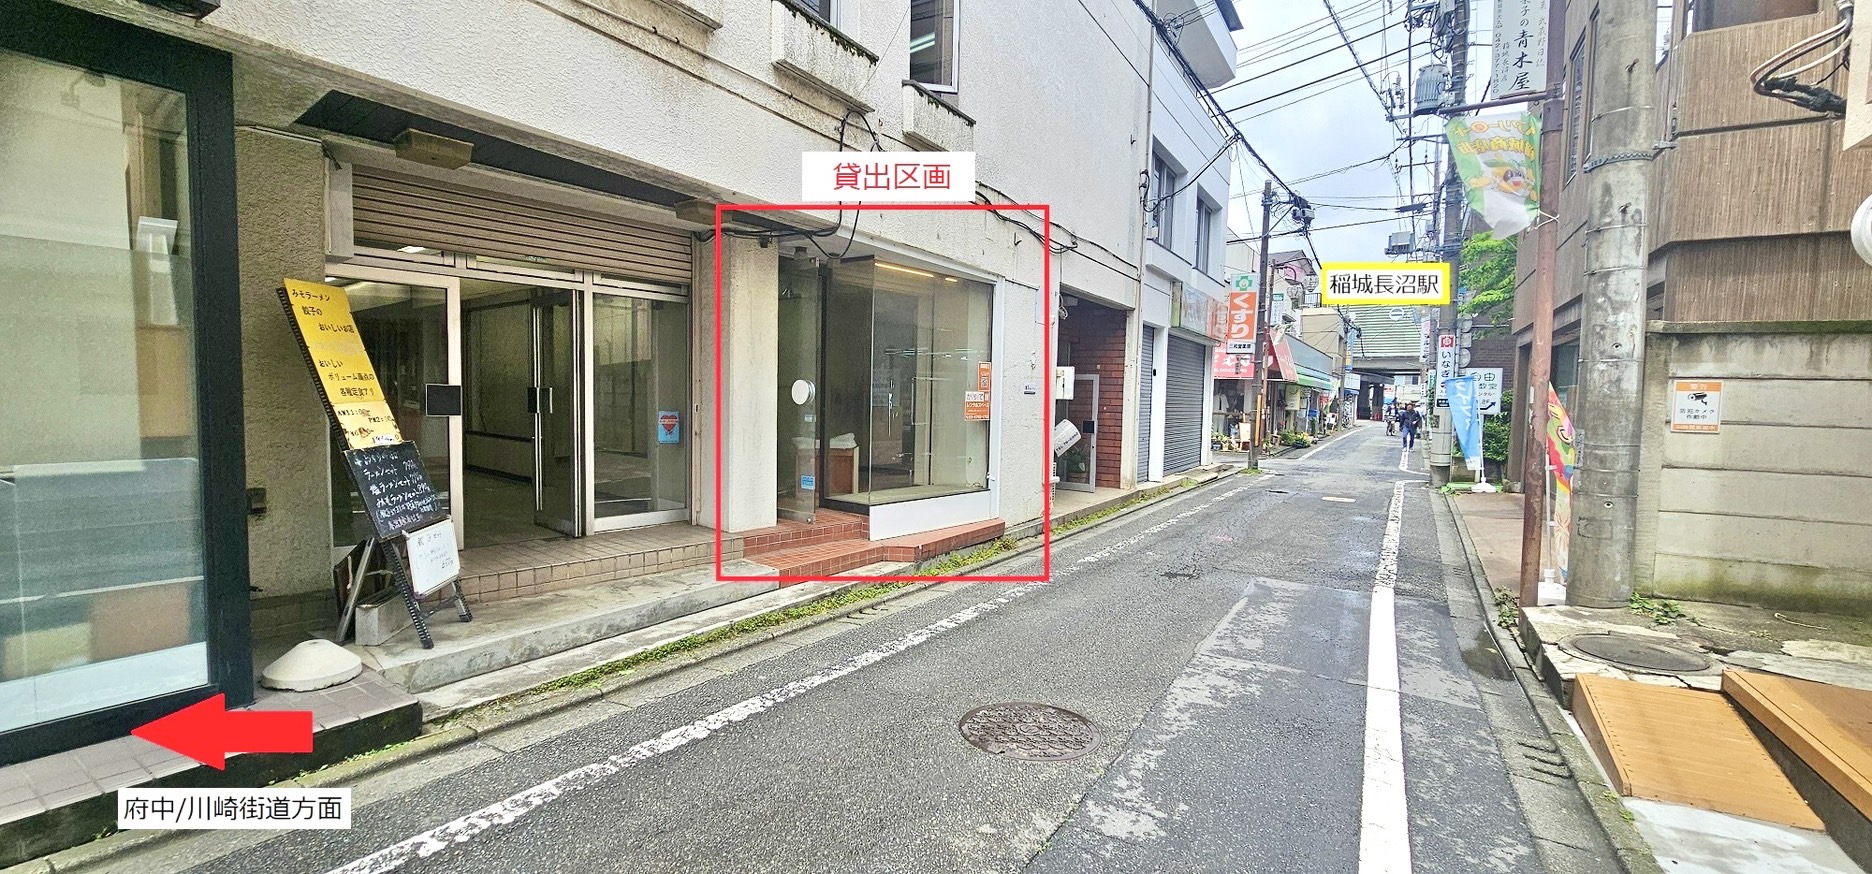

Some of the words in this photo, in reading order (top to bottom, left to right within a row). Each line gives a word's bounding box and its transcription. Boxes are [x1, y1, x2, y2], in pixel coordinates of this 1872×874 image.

[292, 289, 331, 302] みそラーメン
[1230, 293, 1253, 339] くすり
[318, 322, 355, 334] おいしいお店
[318, 358, 344, 368] おいしい
